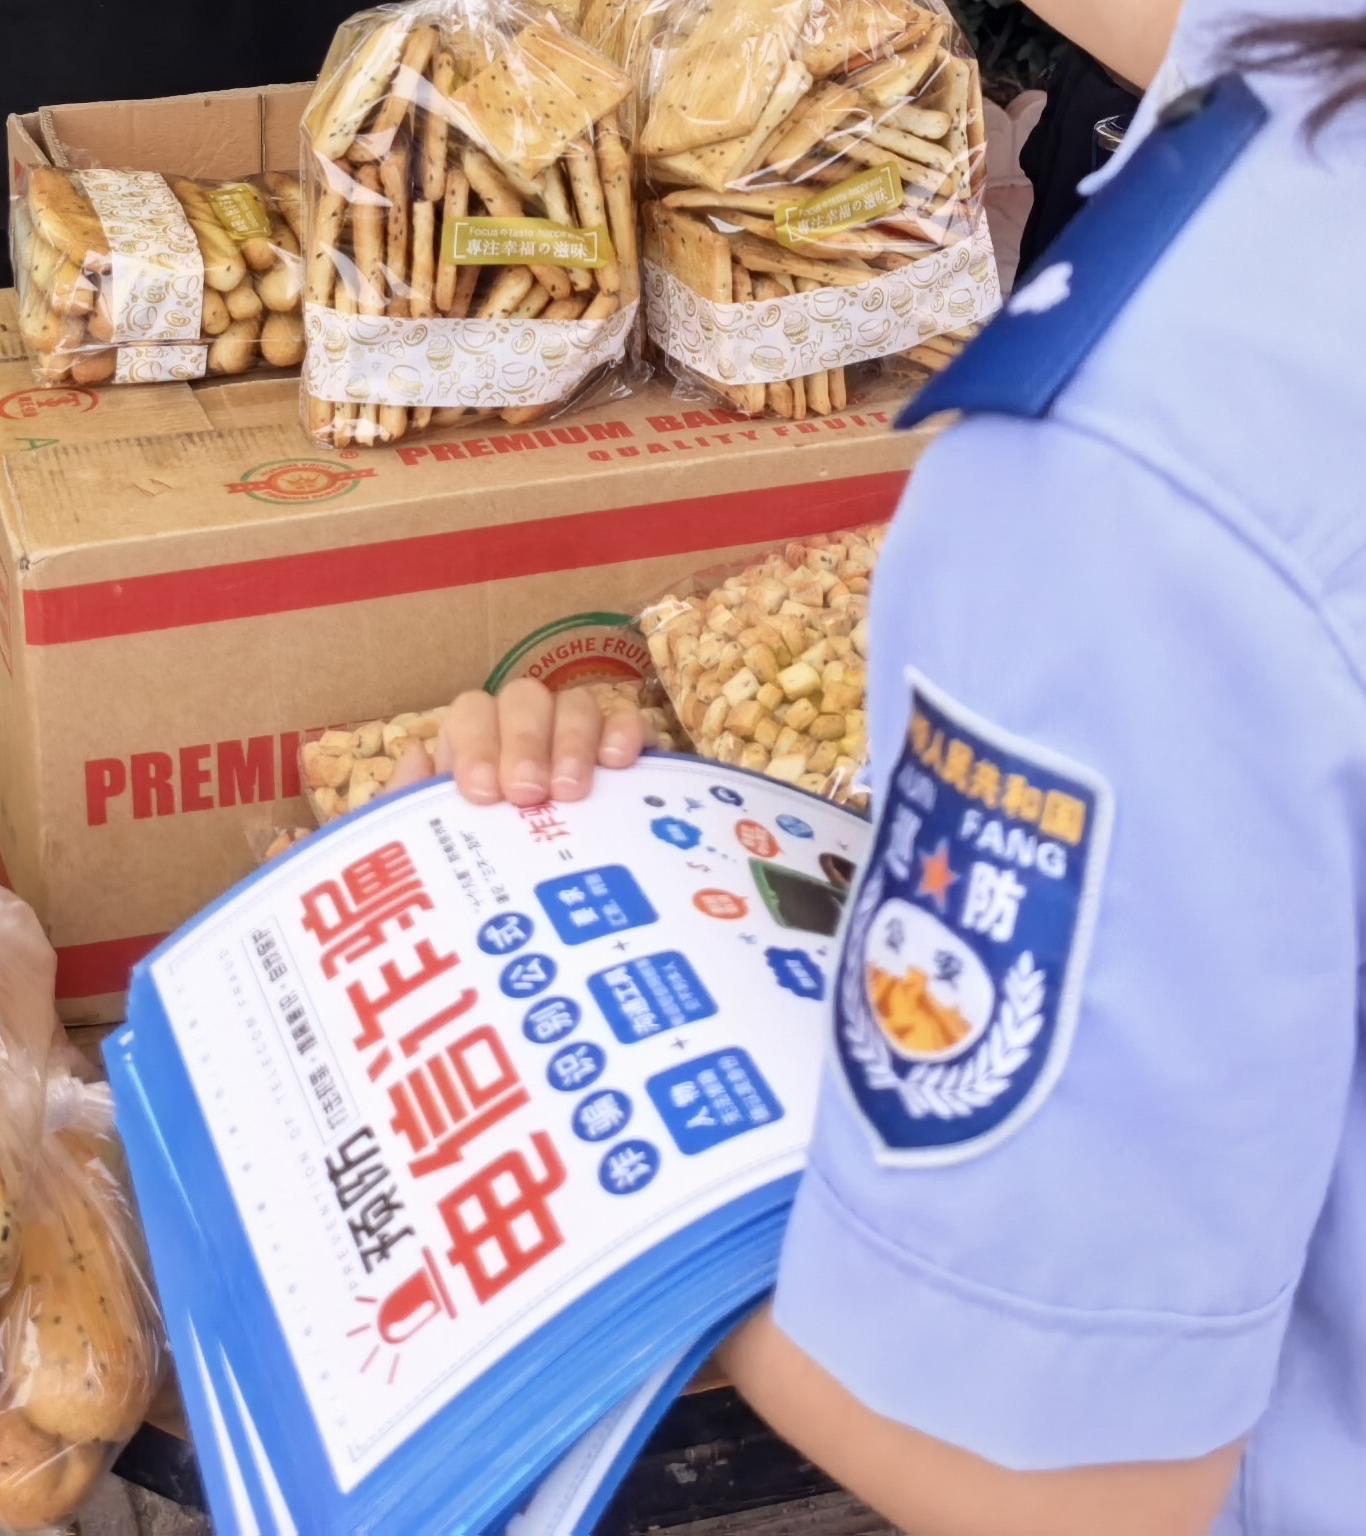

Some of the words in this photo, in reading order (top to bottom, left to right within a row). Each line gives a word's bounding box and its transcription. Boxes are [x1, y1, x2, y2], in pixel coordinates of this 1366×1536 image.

[396, 420, 633, 466] PREMIUM
[587, 430, 758, 462] QUALITY
[773, 411, 888, 437] FRUIT
[523, 637, 596, 682] ONGHE
[85, 724, 347, 827] PREMI
[961, 808, 1067, 879] FANG
[962, 861, 1026, 942] 防
[300, 839, 568, 1305] 电信诈骗
[482, 915, 655, 1191] 诈骗识别公式
[325, 1125, 416, 1273] 预防
